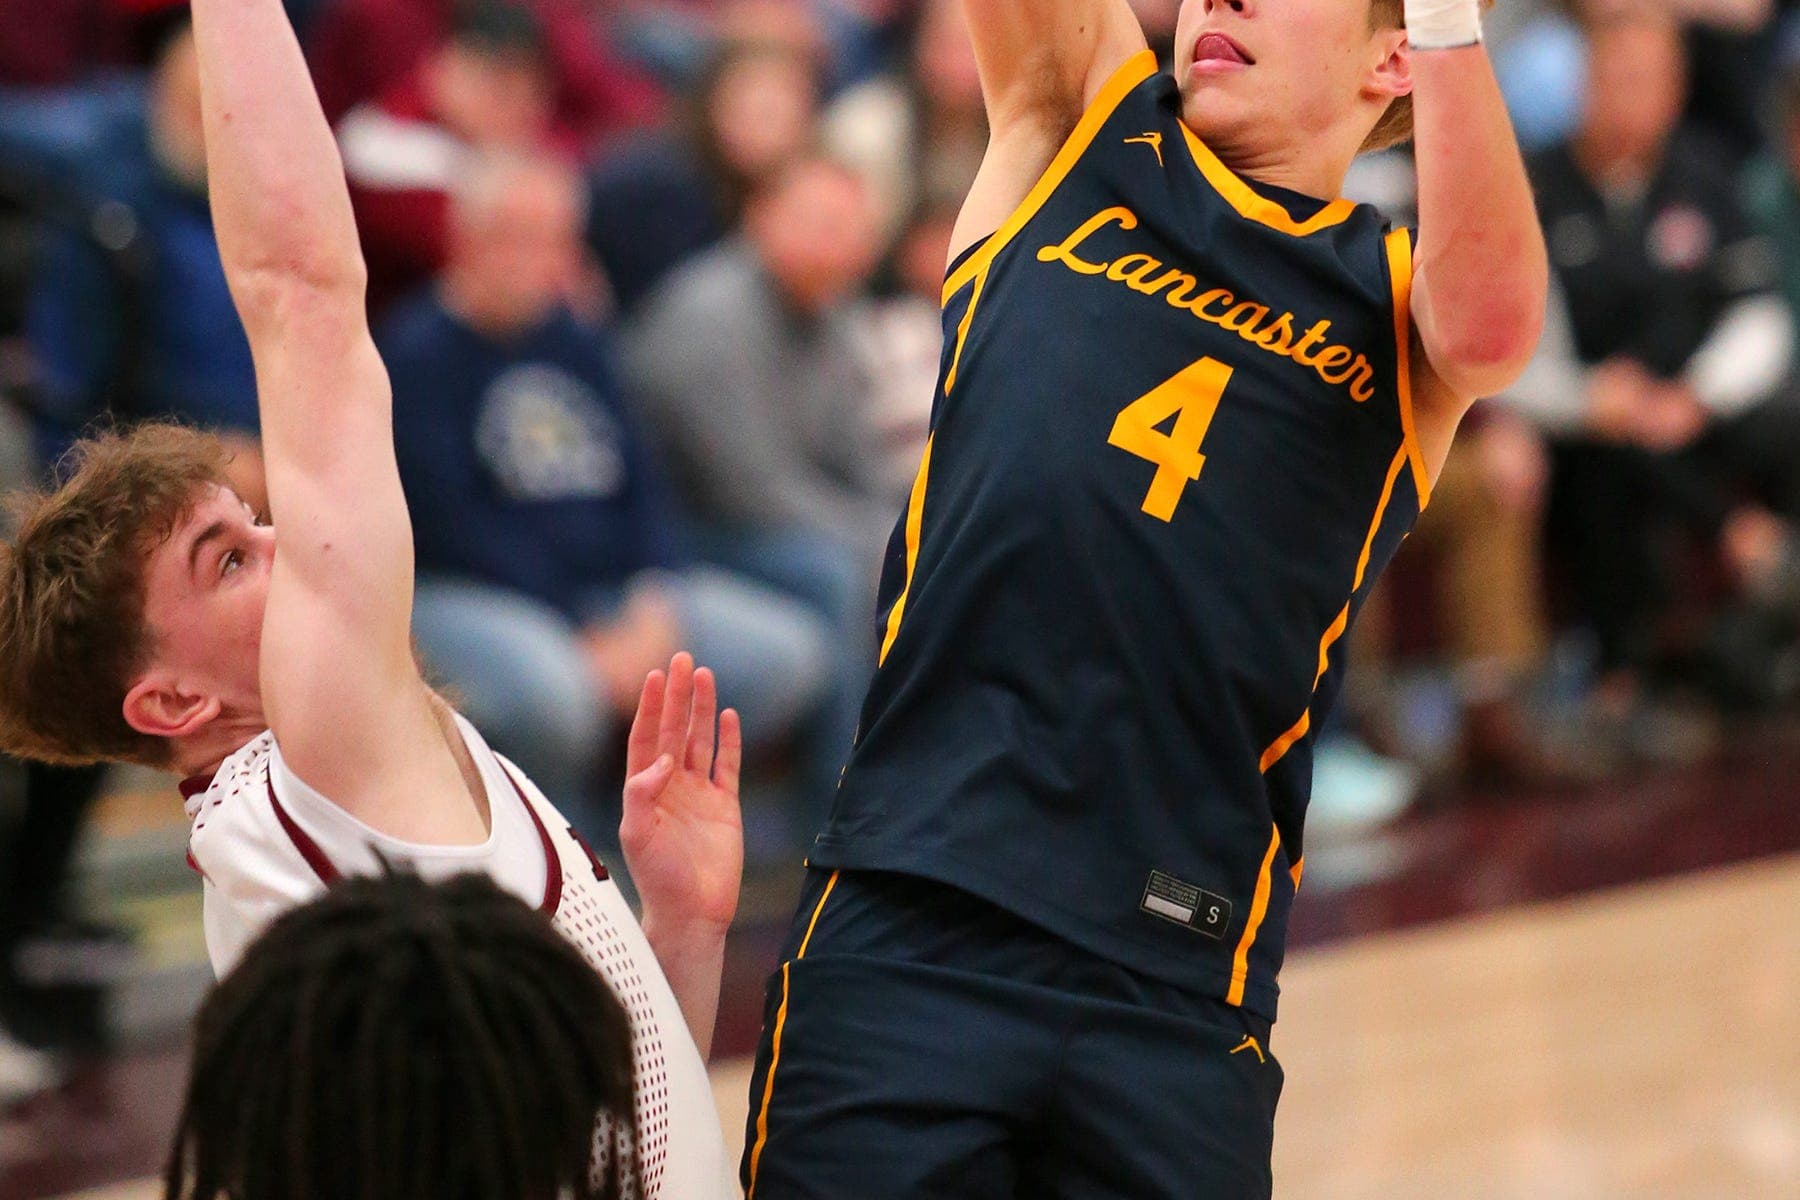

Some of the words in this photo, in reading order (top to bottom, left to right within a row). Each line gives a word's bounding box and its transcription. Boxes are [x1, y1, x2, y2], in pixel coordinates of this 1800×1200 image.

[1036, 206, 1375, 402] Lancaster
[1107, 355, 1234, 523] 4
[1206, 906, 1220, 924] S
